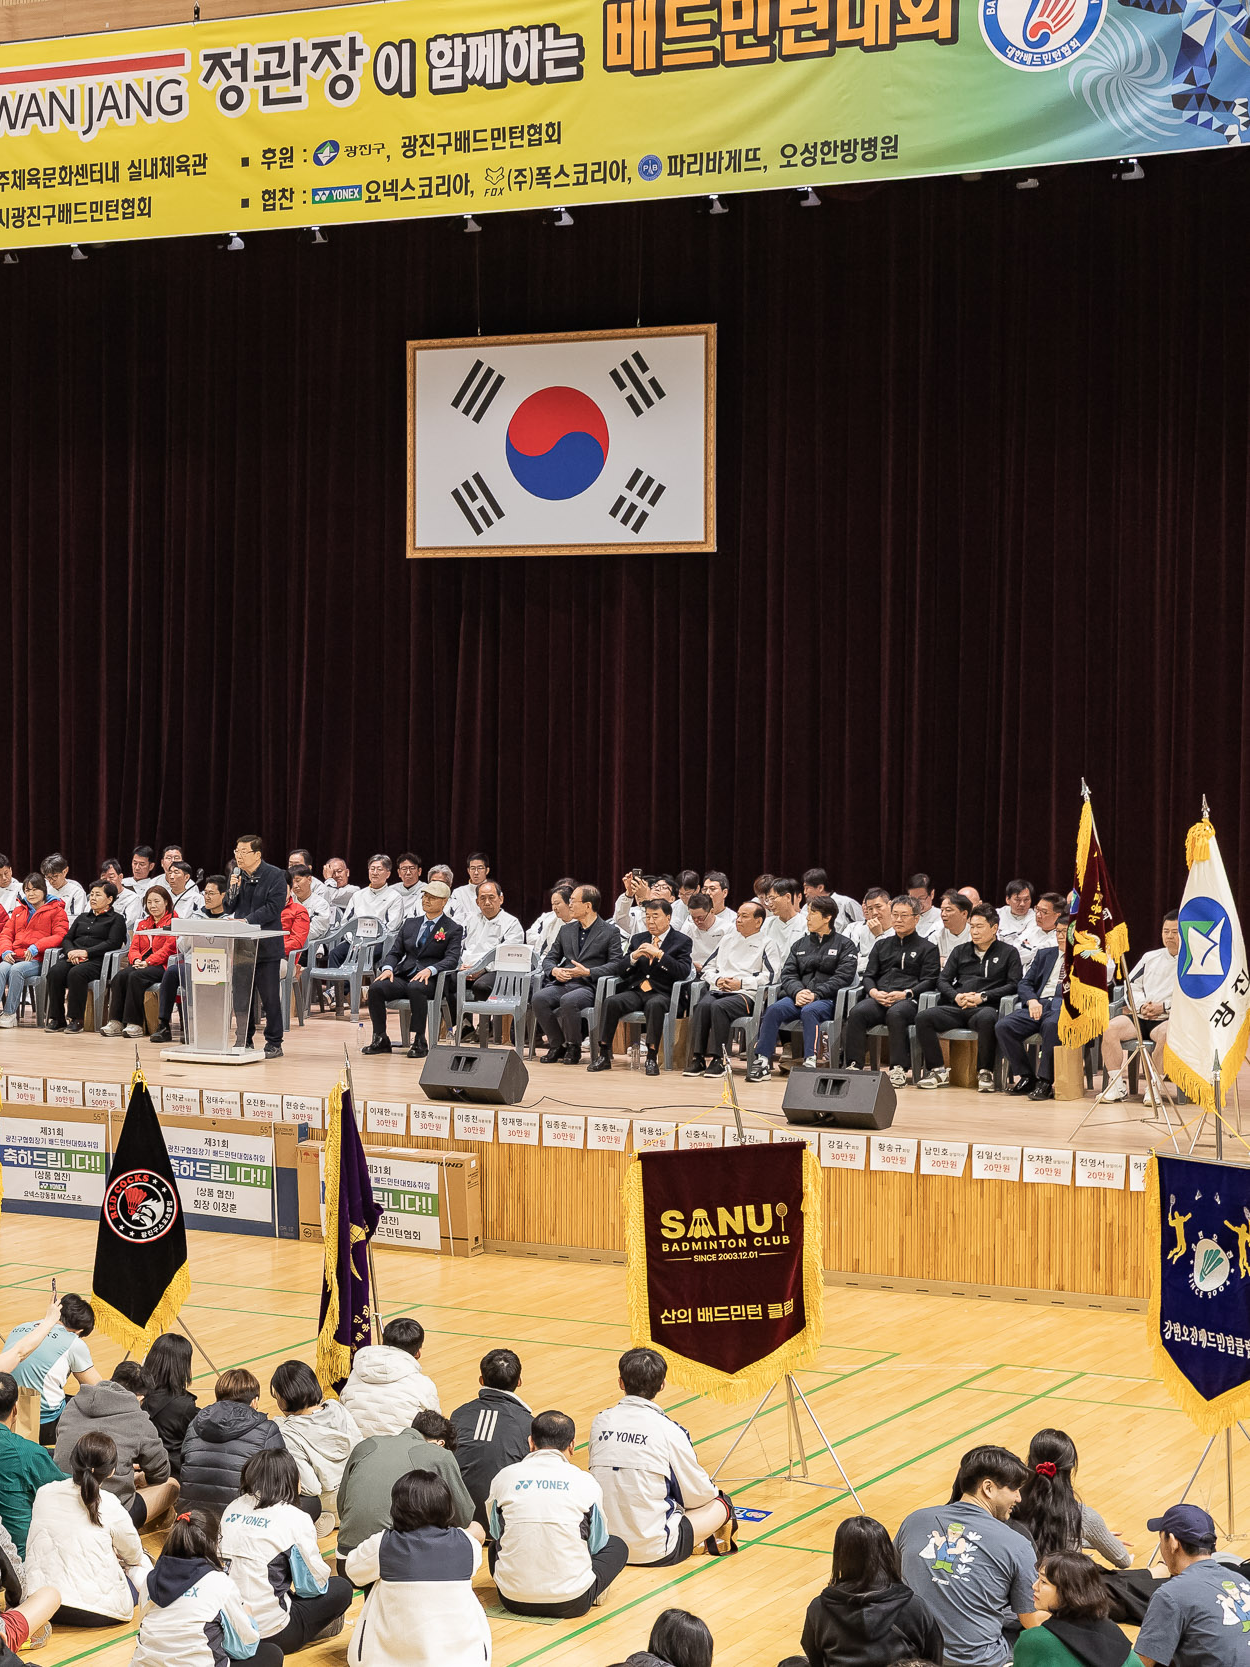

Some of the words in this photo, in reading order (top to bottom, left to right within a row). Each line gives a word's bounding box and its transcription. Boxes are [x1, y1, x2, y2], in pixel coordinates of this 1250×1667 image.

[1006, 38, 1081, 66] 대한배드민턴협회
[202, 36, 364, 112] 정관장
[375, 40, 414, 97] 이
[428, 24, 583, 96] 함께하는
[260, 145, 294, 170] 후원
[401, 121, 563, 160] 광진구배드민턴협회
[127, 152, 209, 181] 실내체육관
[260, 187, 294, 212] 협찬
[332, 187, 360, 200] YONEX
[365, 173, 475, 204] 요넥스코리아,
[484, 186, 505, 198] FOX
[507, 160, 632, 192] (주)폭스코리아,
[667, 147, 768, 178] 파리바게뜨,
[779, 134, 899, 169] 오성한방병원
[16, 1091, 36, 1101] 30만원
[55, 1094, 75, 1103] 30만원
[171, 1103, 192, 1113] 30만원
[211, 1106, 232, 1115] 30만원
[252, 1110, 273, 1118] 30만원
[291, 1112, 313, 1121] 30만원
[376, 1118, 398, 1128] 30만원
[419, 1122, 441, 1132] 30만원
[40, 1126, 64, 1138] 제31회
[463, 1125, 486, 1134] 30만원
[508, 1129, 530, 1139] 30만원
[552, 1132, 575, 1142] 30만원
[597, 1135, 621, 1144] 30만원
[204, 1138, 229, 1150] 제31회
[3, 1148, 102, 1174] 축하드립니다!!
[830, 1152, 856, 1162] 30만원
[881, 1155, 907, 1165] 30만원
[931, 1160, 957, 1170] 20만원
[983, 1163, 1010, 1173] 20만원
[1034, 1167, 1061, 1177] 20만원
[1087, 1171, 1114, 1181] 20만원
[109, 1195, 119, 1220] RED
[114, 1174, 150, 1194] COCKS
[193, 1200, 210, 1211] 회장
[662, 1239, 747, 1253] BADMINTON
[753, 1235, 791, 1247] CLUB
[693, 1253, 717, 1262] SINCE
[718, 1252, 759, 1261] 2003.12.01
[660, 1307, 692, 1325] 산의
[697, 1304, 763, 1322] 배드민턴
[767, 1298, 794, 1320] 클럽
[616, 1431, 648, 1446] YONEX
[536, 1480, 570, 1491] YONEX
[241, 1514, 270, 1529] YONEX
